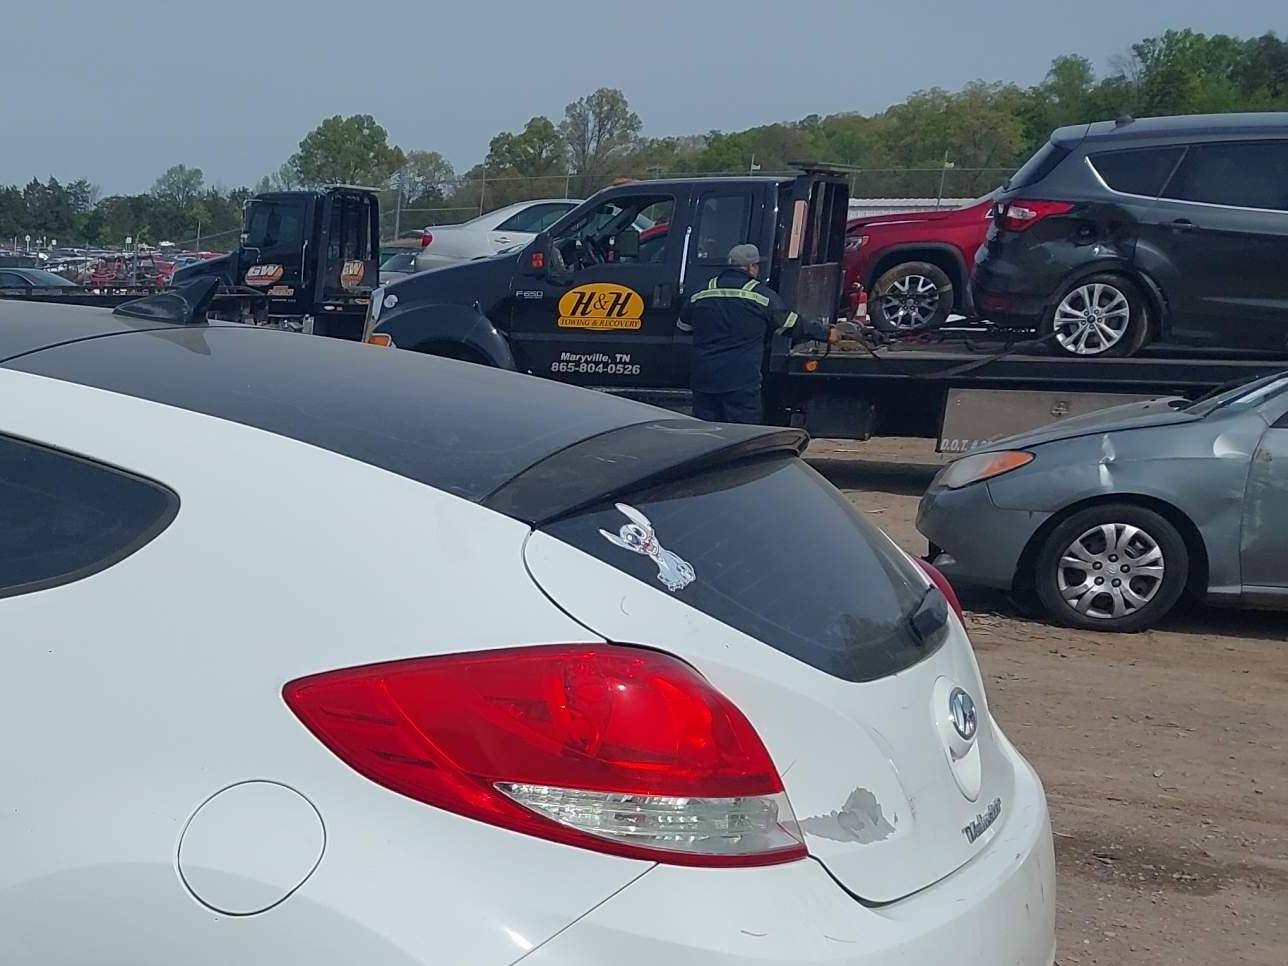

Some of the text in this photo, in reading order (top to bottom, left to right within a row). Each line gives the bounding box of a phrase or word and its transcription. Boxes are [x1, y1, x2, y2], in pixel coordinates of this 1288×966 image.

[561, 319, 590, 327] TOWING
[599, 320, 638, 328] RECOVERY
[560, 352, 631, 363] Maryville, TN
[551, 362, 641, 375] 865-804-0526
